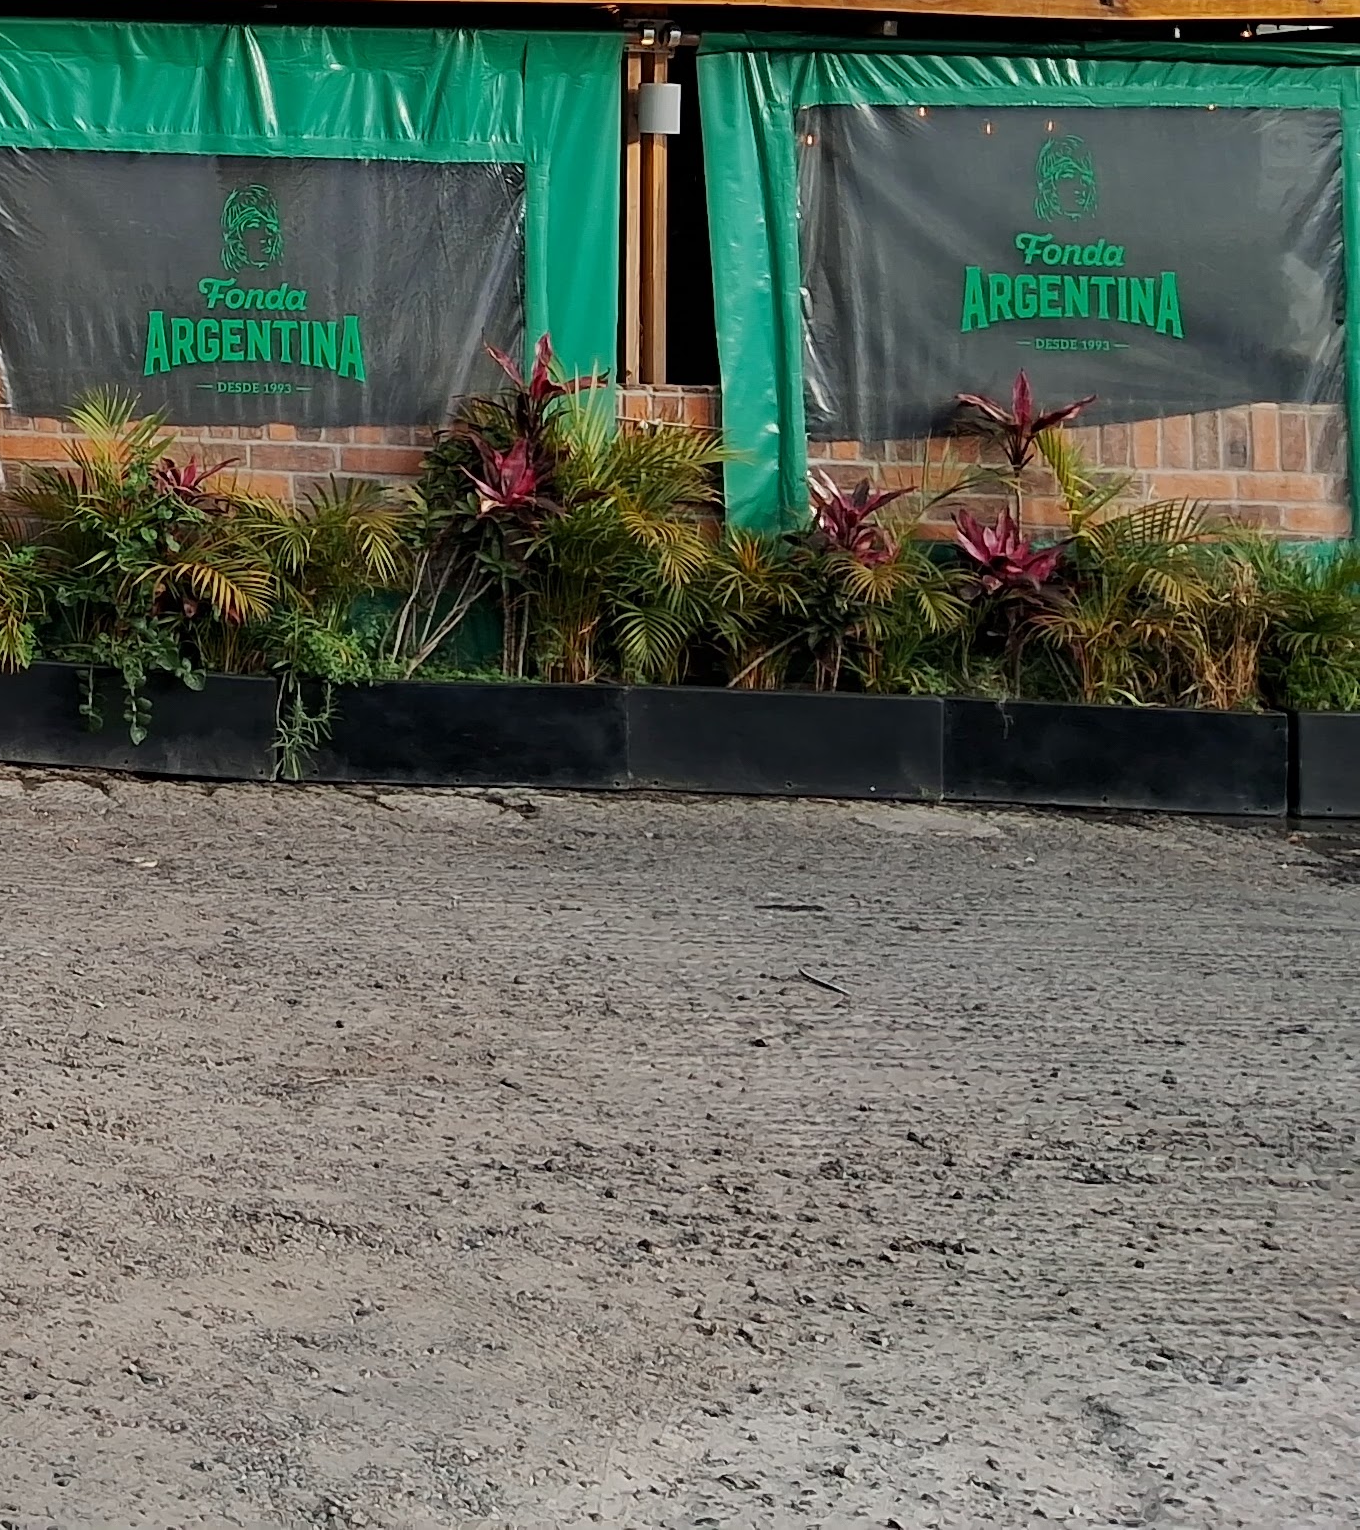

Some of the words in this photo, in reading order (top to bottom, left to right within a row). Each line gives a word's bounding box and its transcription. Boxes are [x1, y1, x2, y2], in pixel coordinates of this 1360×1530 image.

[1015, 233, 1125, 266] Fonda
[198, 277, 307, 311] Fonda
[961, 266, 1184, 339] ARGENTINA
[144, 311, 365, 383] ARGENTINA
[1036, 339, 1077, 350] DESDE
[1081, 340, 1109, 350] 1993
[217, 382, 259, 393] DESDE
[264, 383, 291, 393] 1993
